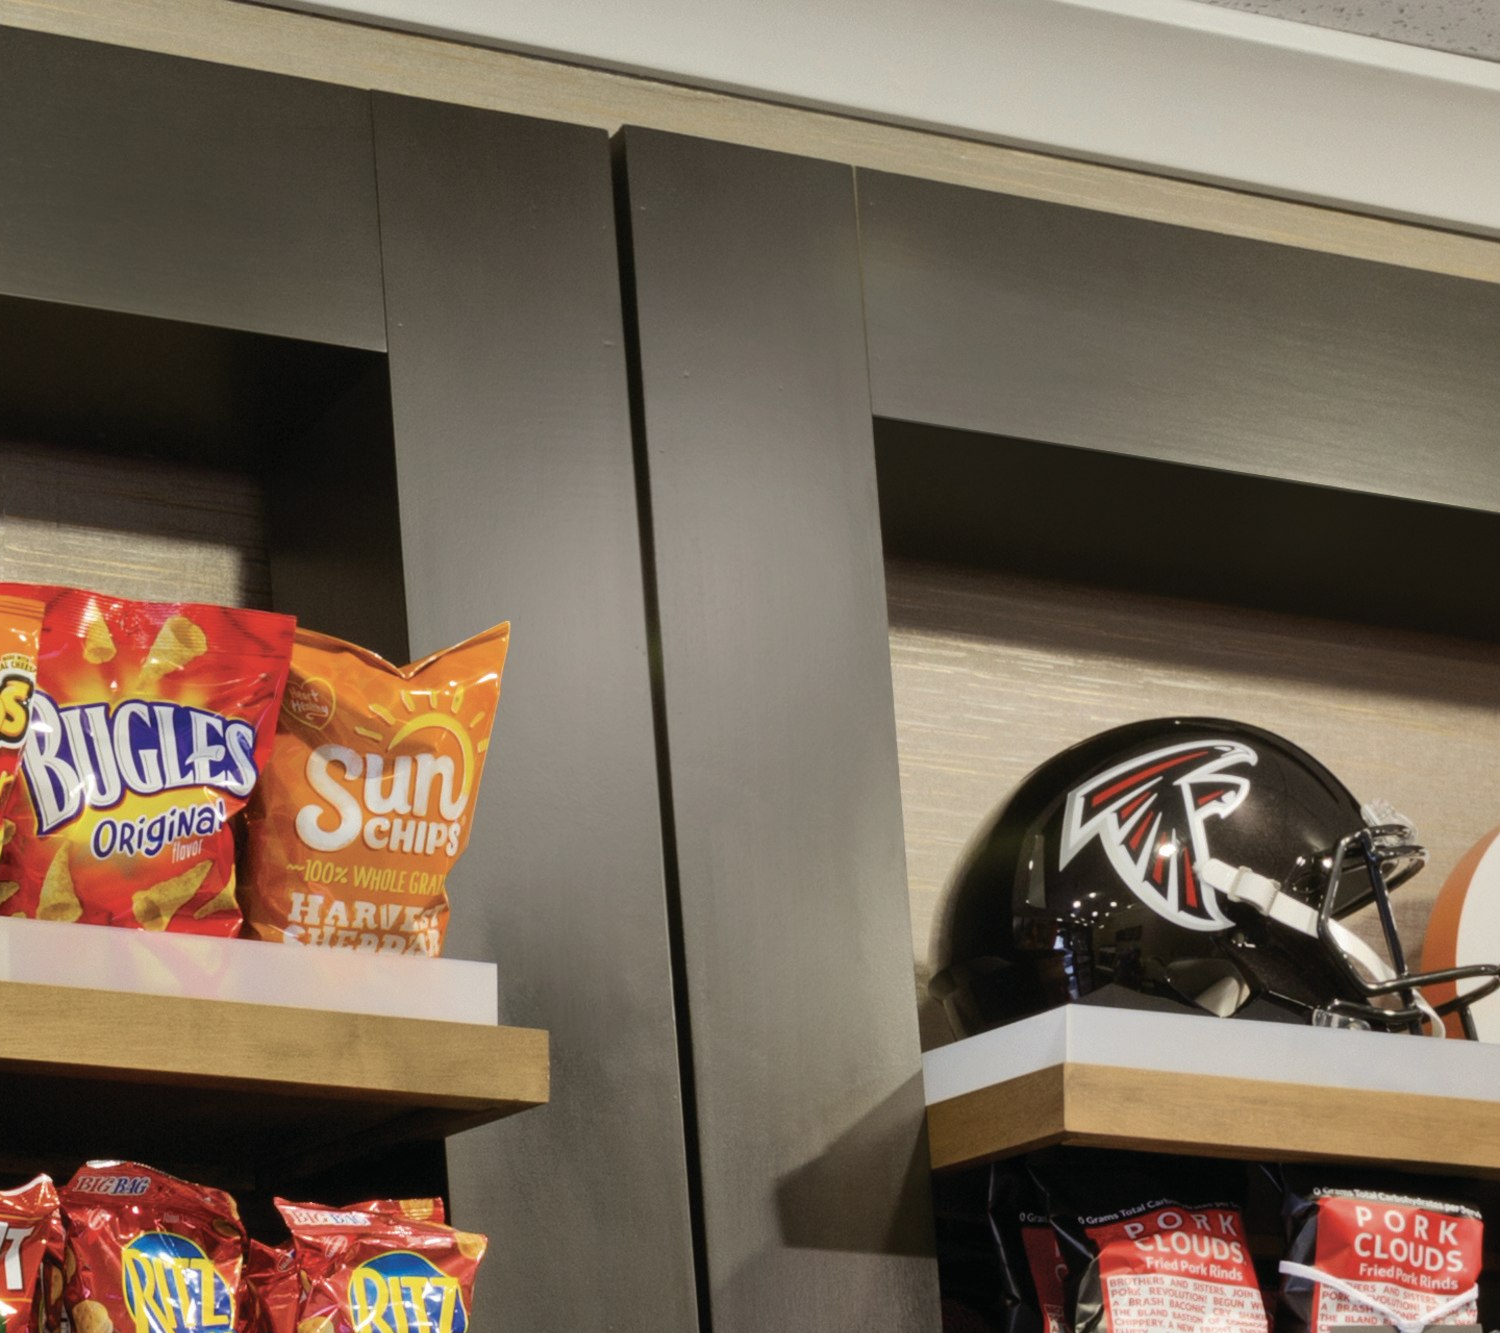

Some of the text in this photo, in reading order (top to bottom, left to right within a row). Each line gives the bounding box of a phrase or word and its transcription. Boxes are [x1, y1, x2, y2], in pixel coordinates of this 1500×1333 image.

[22, 697, 257, 835] BUGLES
[363, 817, 461, 856] CHIPS
[288, 892, 439, 932] HARVEST
[1124, 1211, 1237, 1239] PORK
[1355, 1205, 1458, 1245] PORK
[1134, 1231, 1244, 1264] CLOUDS
[1354, 1233, 1463, 1272] CLOUDS
[1146, 1257, 1242, 1281] Fried Pork Rinds
[1360, 1263, 1458, 1290] Fried Pork Rinds
